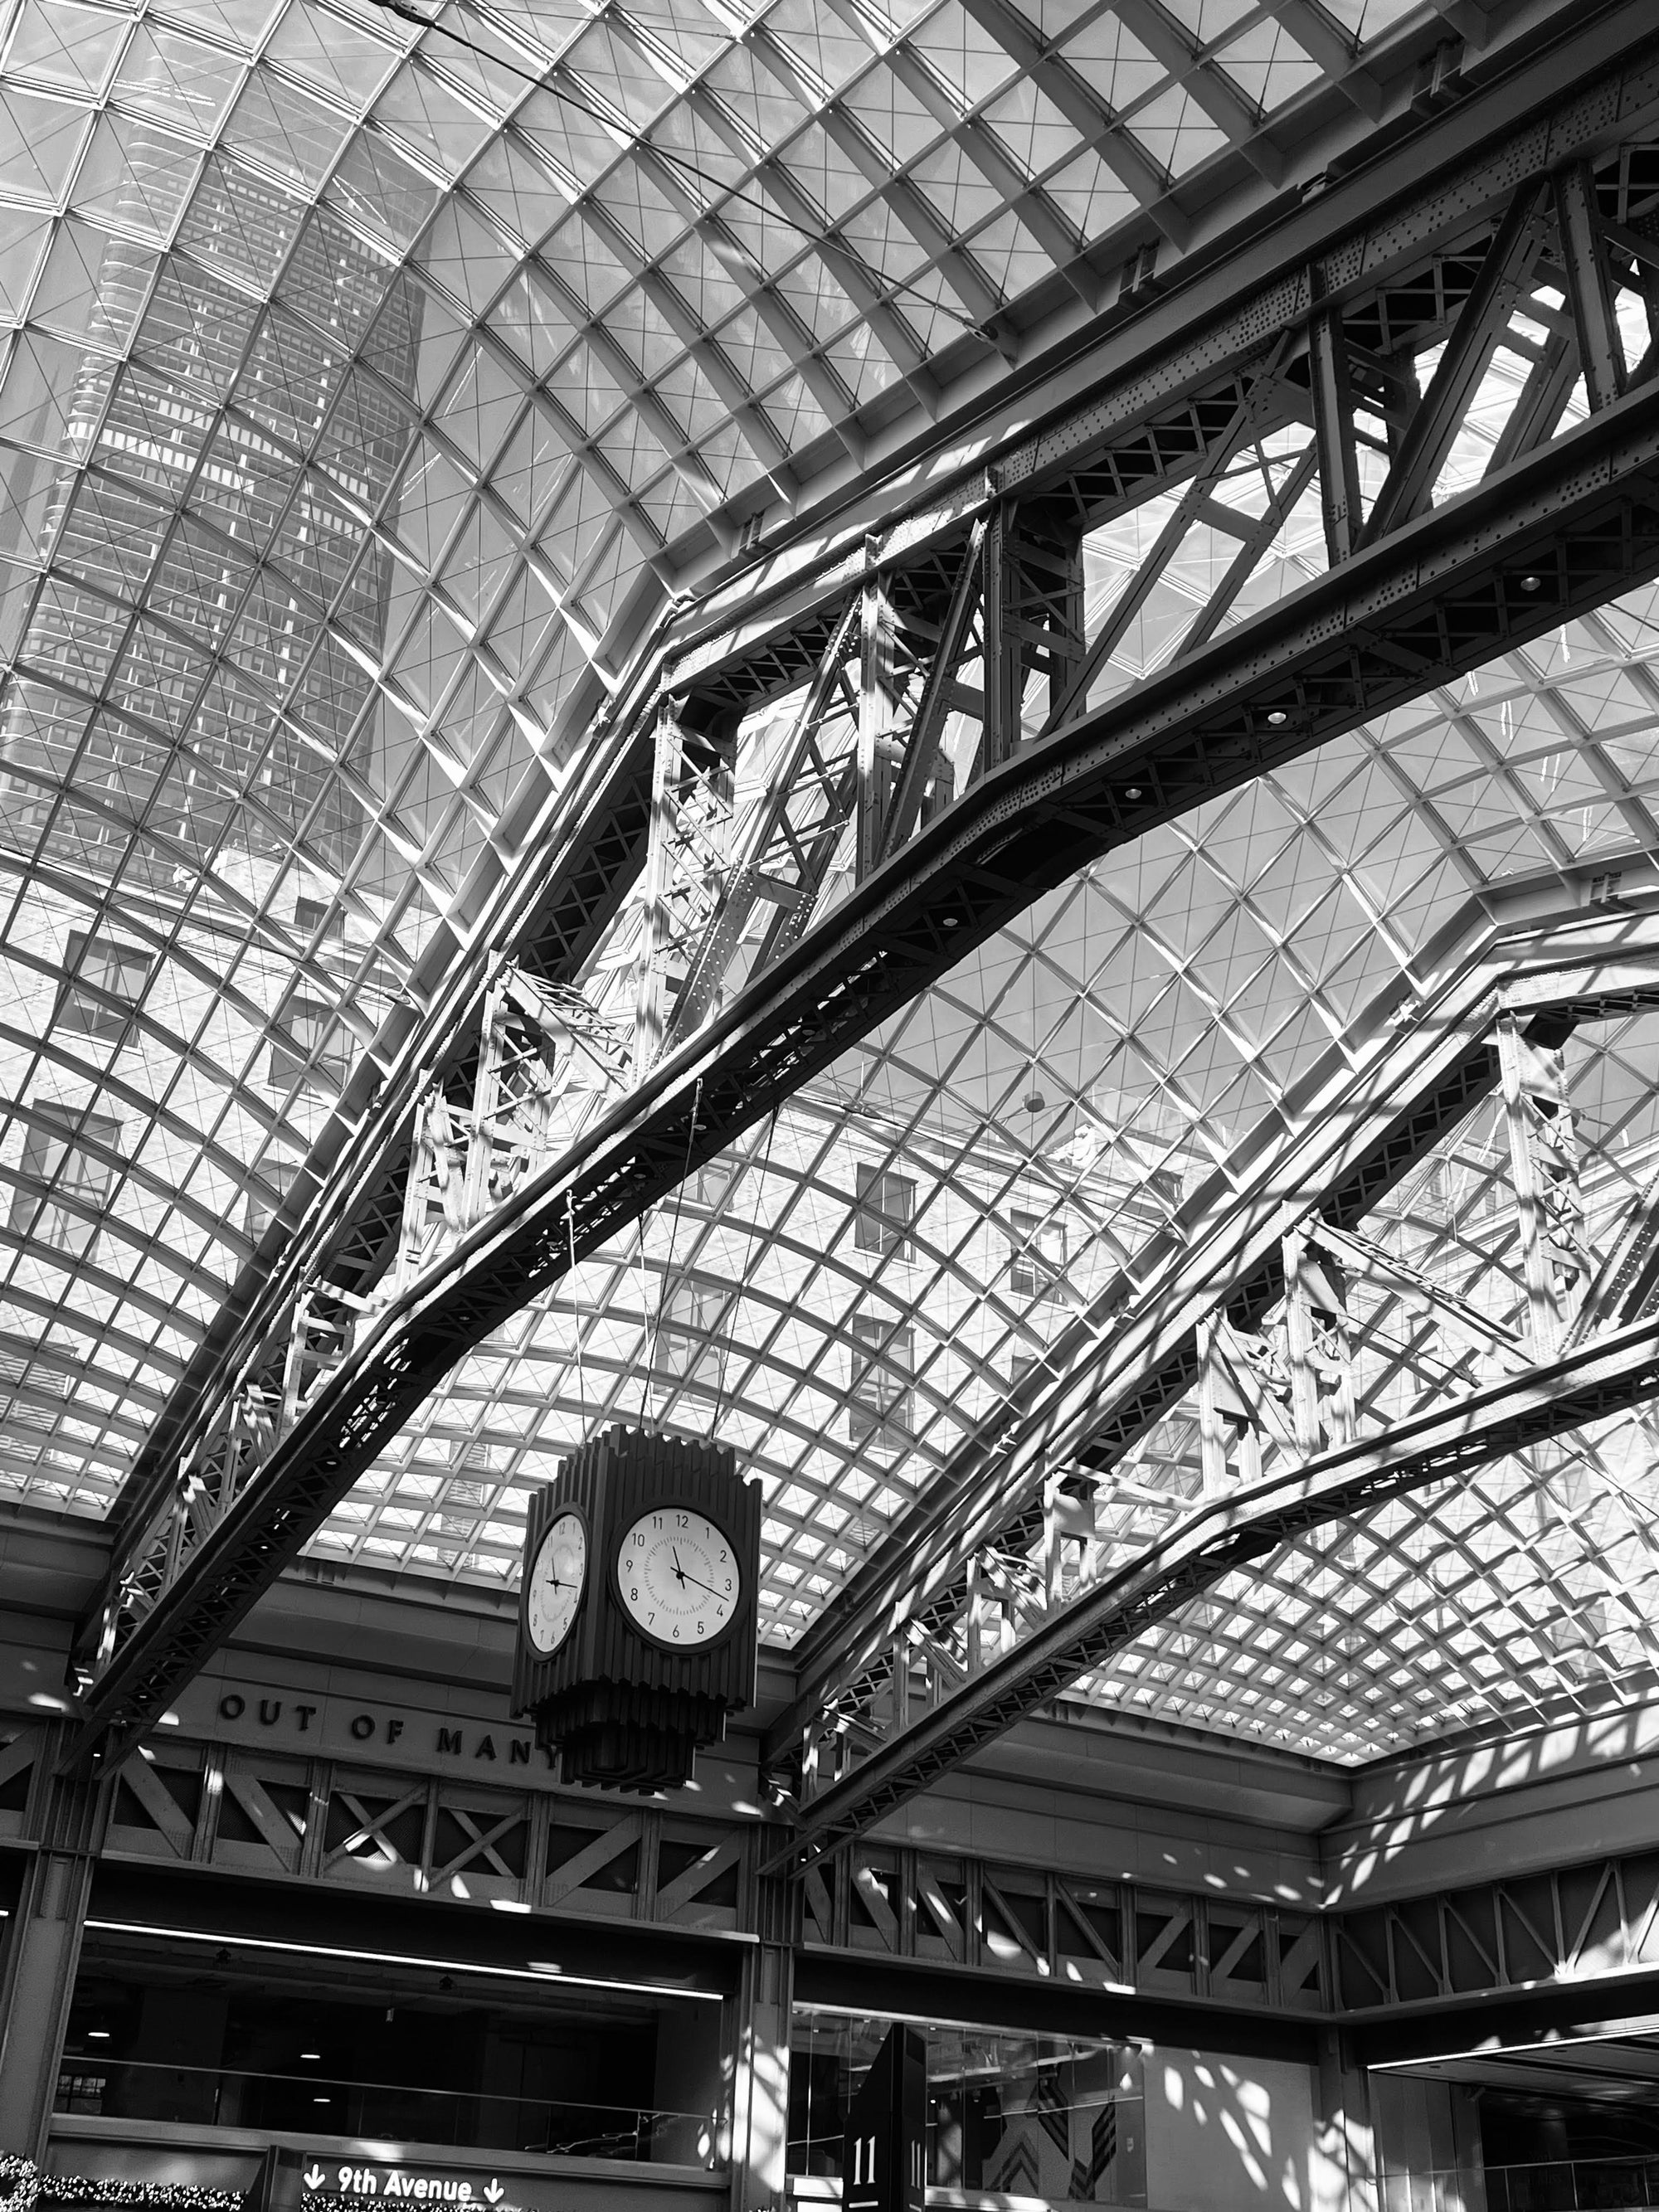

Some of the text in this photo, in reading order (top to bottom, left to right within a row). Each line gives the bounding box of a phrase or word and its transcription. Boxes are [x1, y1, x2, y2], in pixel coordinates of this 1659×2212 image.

[558, 1521, 566, 1536] 12
[652, 1515, 663, 1530] 11
[675, 1514, 689, 1529] 12
[631, 1532, 645, 1548] 10
[705, 1527, 710, 1540] 1
[719, 1549, 727, 1563] 2
[625, 1559, 634, 1573] 9
[724, 1578, 732, 1592] 3
[630, 1587, 639, 1602] 8
[716, 1603, 724, 1617] 4
[647, 1612, 655, 1626] 7
[672, 1624, 680, 1638] 6
[696, 1621, 705, 1635] 5
[220, 1694, 562, 1771] OUT OF MANY
[853, 2135, 876, 2185] 11
[338, 2166, 473, 2202] 9th Avenue
